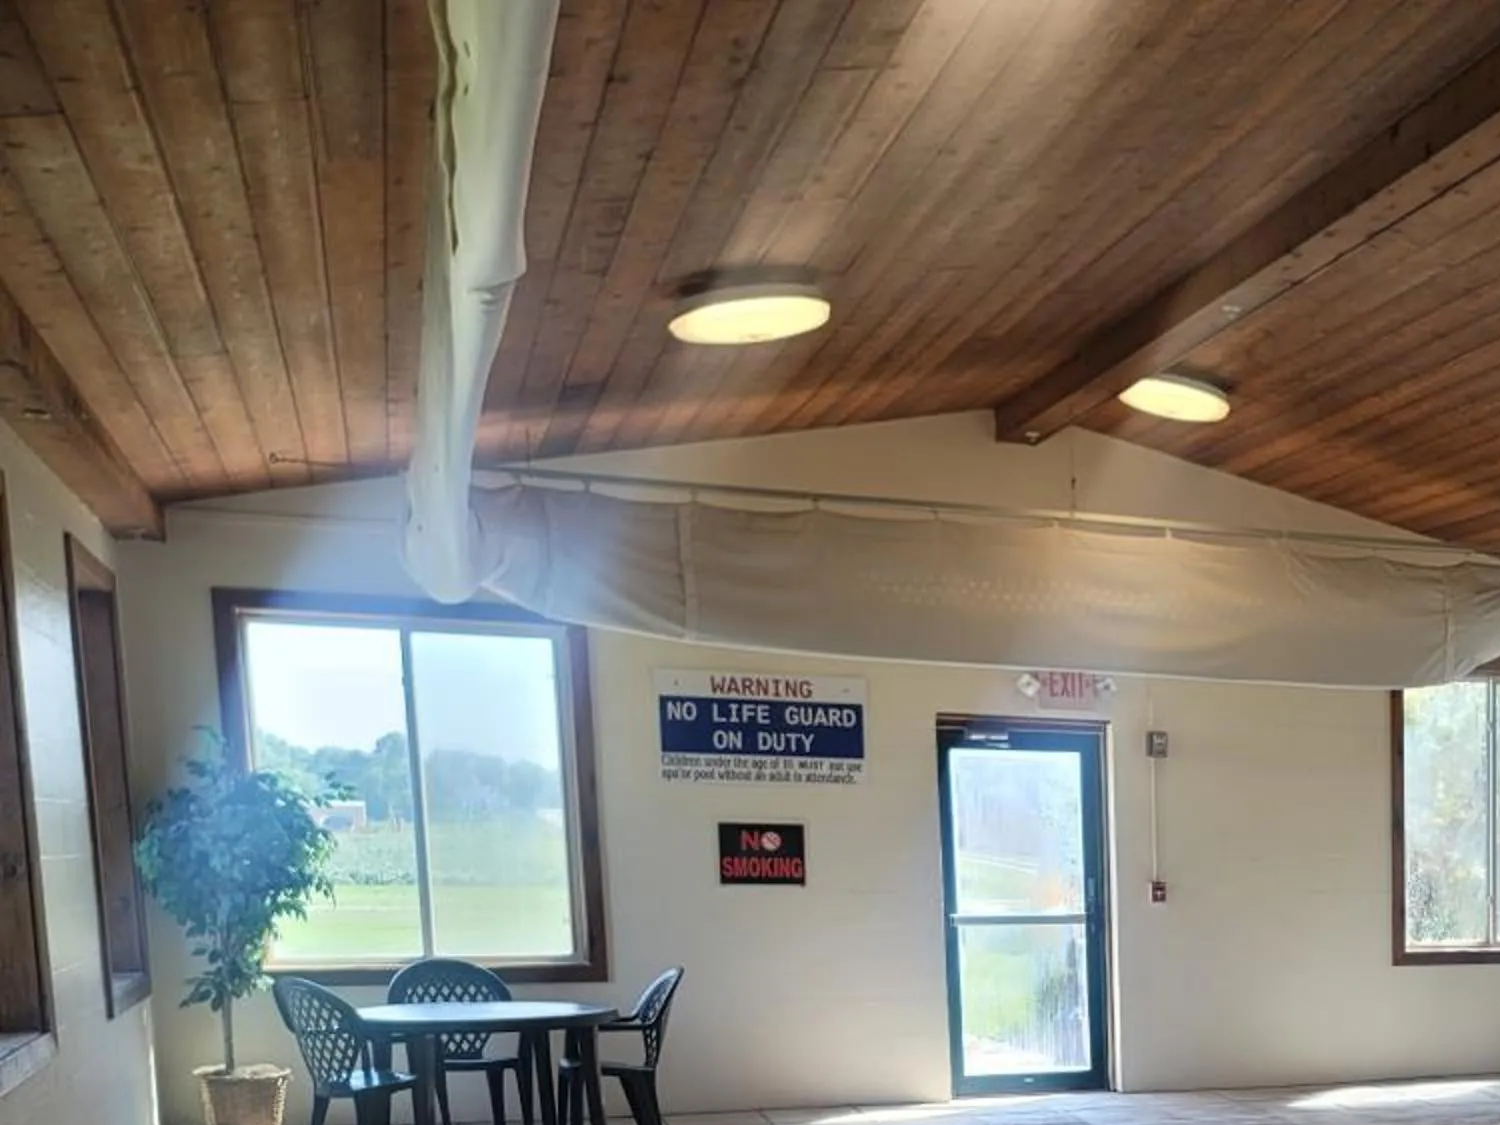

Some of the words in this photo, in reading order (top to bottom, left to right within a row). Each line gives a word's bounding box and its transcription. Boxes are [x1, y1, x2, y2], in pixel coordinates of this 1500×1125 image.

[709, 675, 813, 699] WARNING
[1049, 671, 1085, 698] EXIT
[666, 701, 697, 721] NO
[712, 703, 771, 724] LIFE
[784, 706, 857, 728] GUARD
[712, 730, 743, 749] ON
[757, 732, 815, 752] DUTY
[722, 856, 803, 878] SMOKING
